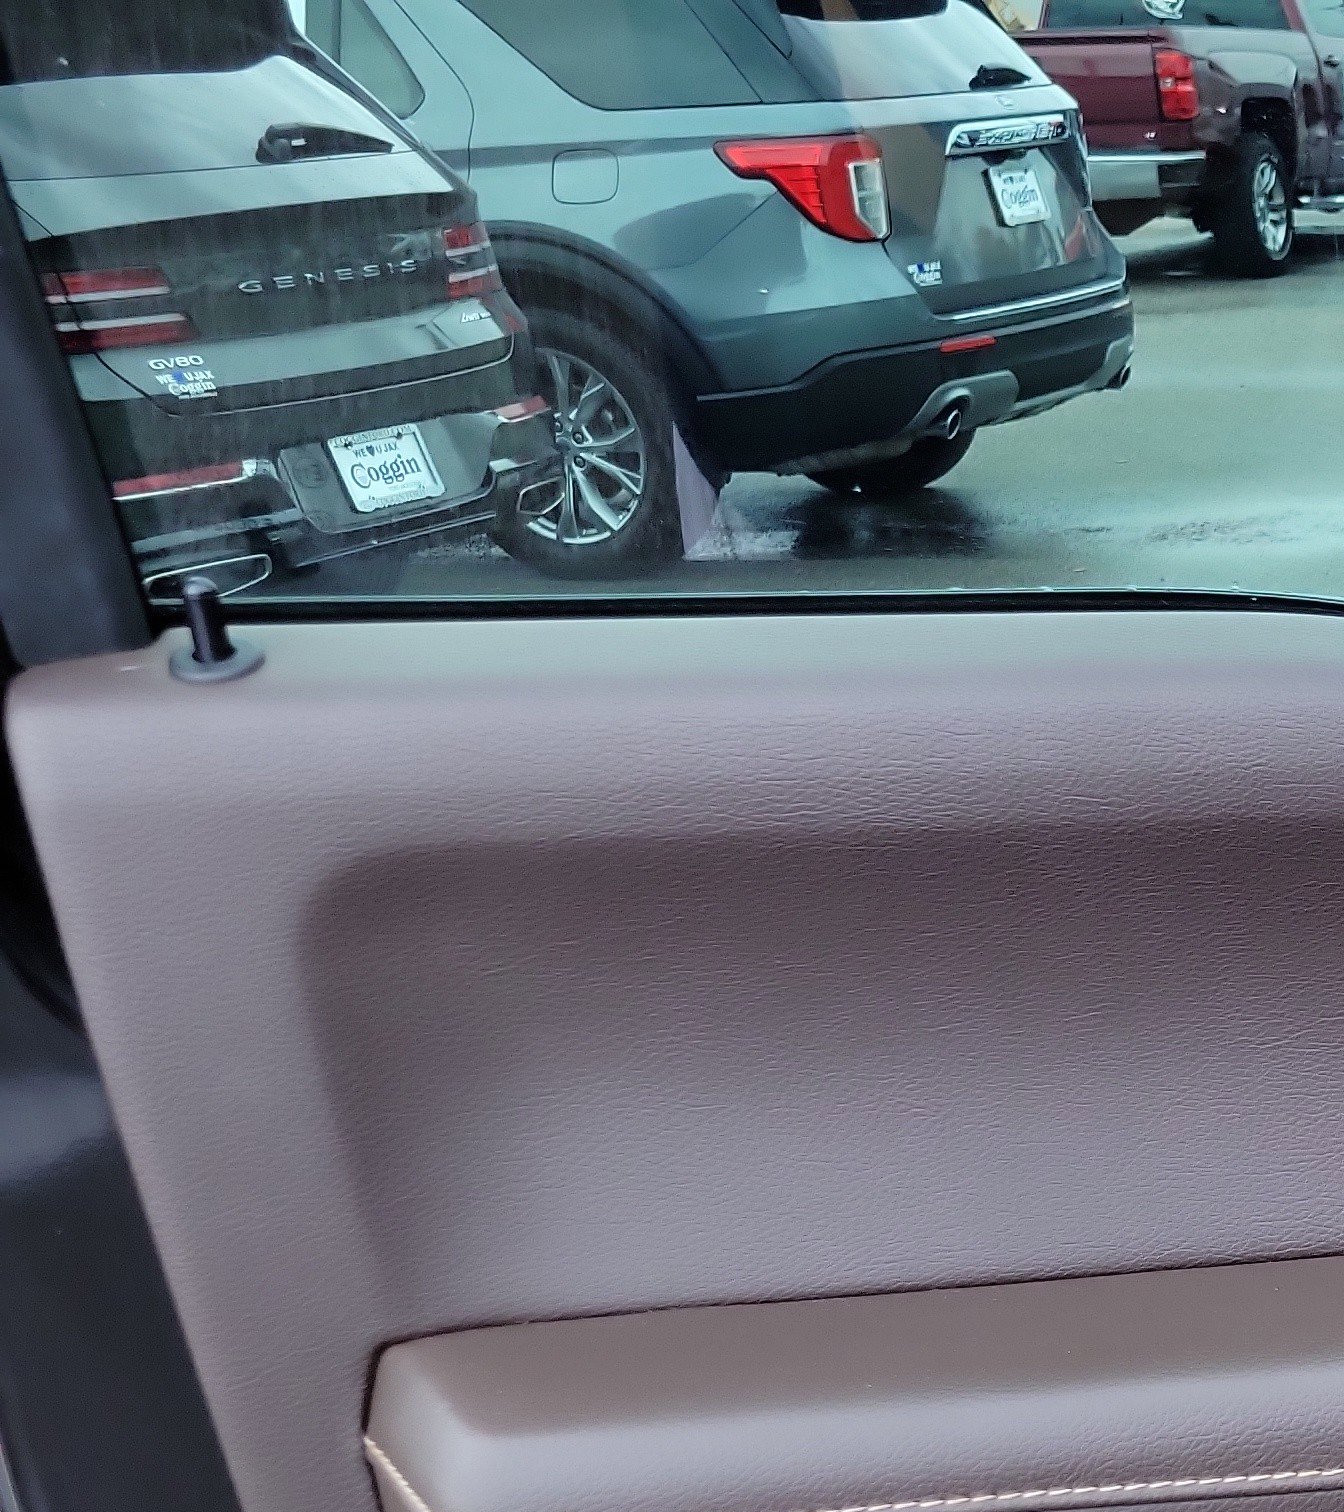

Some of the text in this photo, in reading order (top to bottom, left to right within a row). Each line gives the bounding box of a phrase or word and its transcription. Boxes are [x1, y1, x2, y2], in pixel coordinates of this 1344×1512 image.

[238, 259, 417, 293] GENESIS
[148, 355, 204, 370] GV80
[352, 447, 368, 459] WE
[350, 453, 423, 489] Coggin
